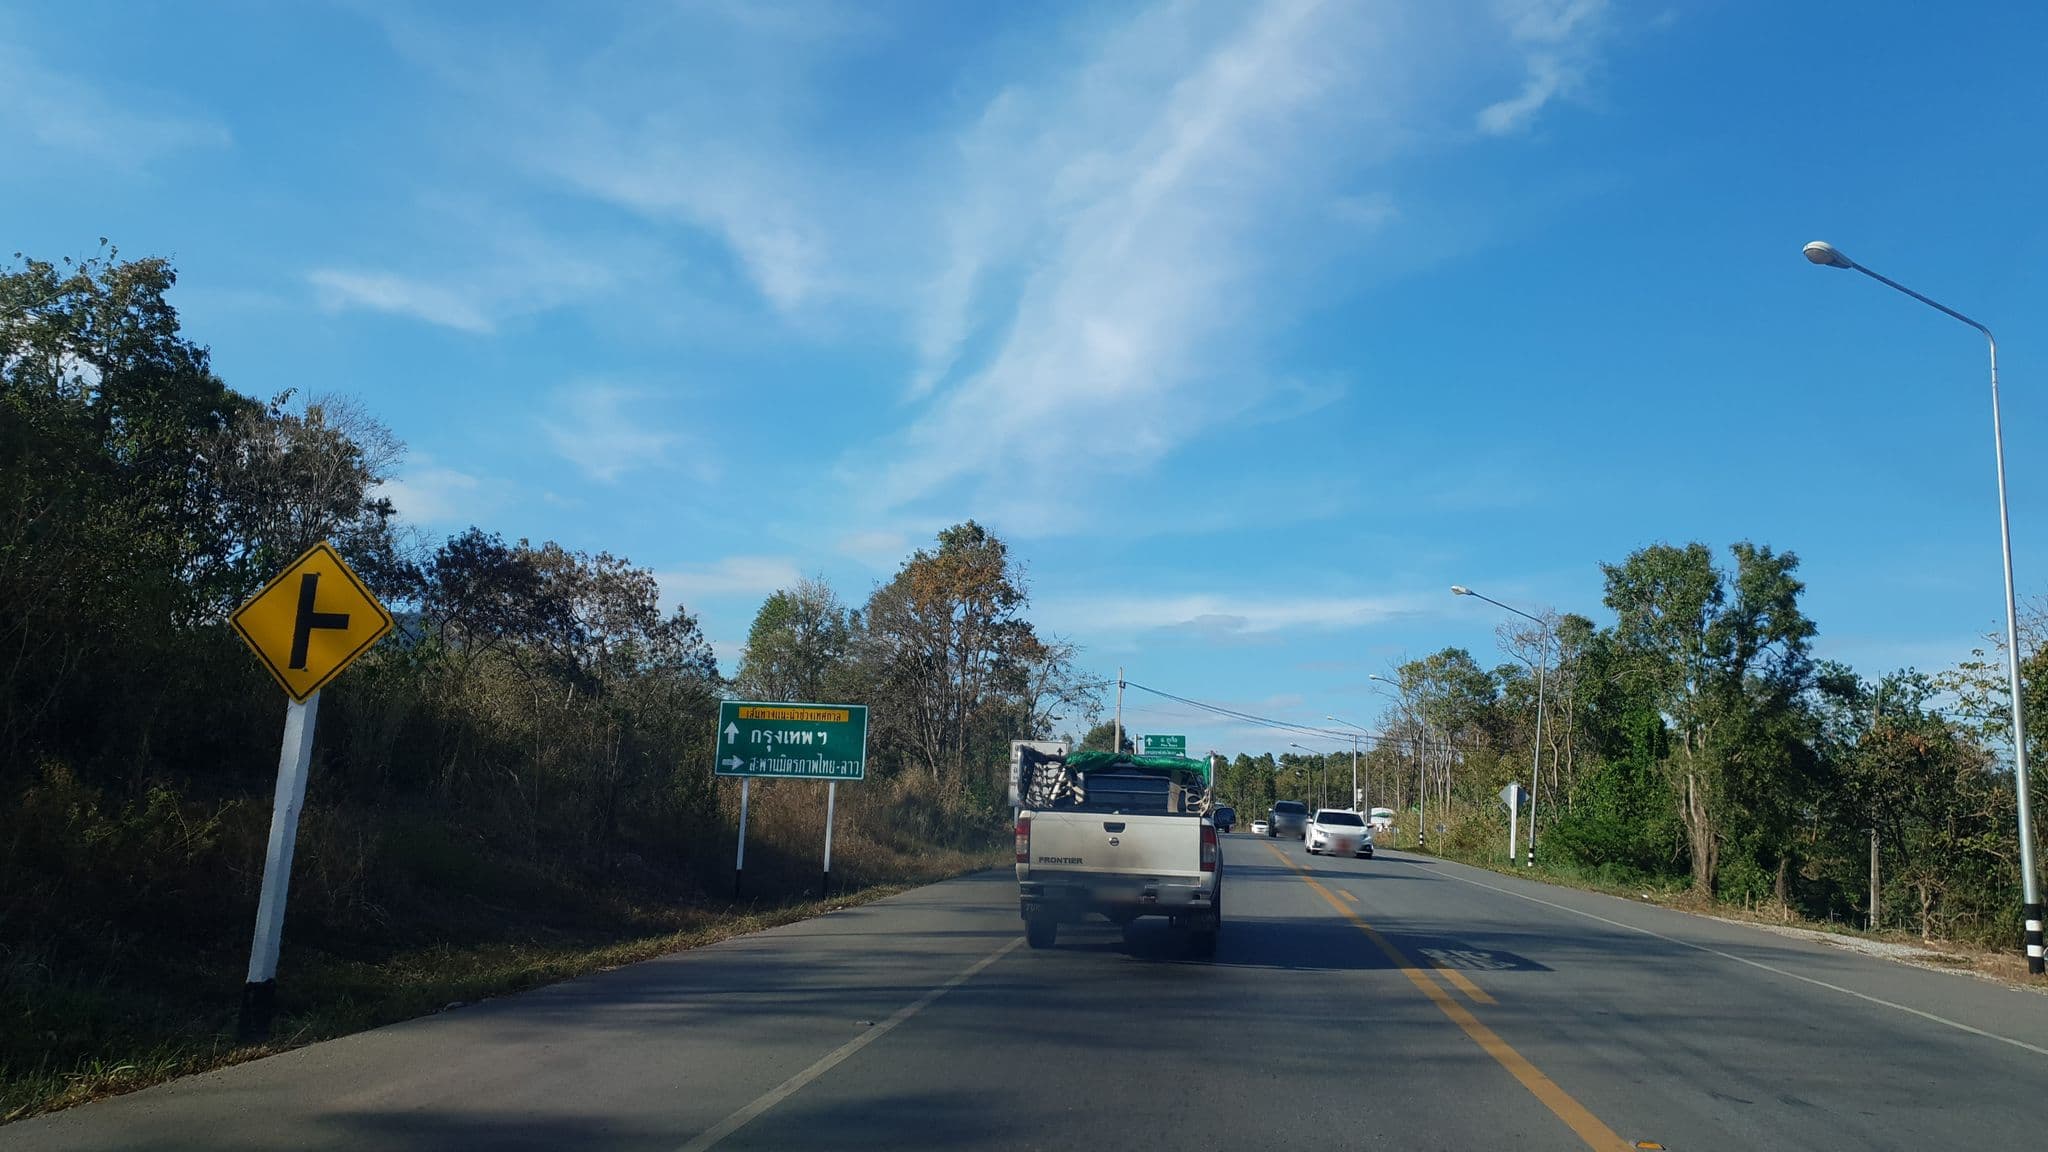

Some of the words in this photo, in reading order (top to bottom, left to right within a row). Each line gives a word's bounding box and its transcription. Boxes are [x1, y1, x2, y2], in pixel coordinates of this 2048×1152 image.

[749, 753, 860, 775] สะพานมิตรภาพไทย-ลาว
[1038, 856, 1083, 865] FRONTIER
